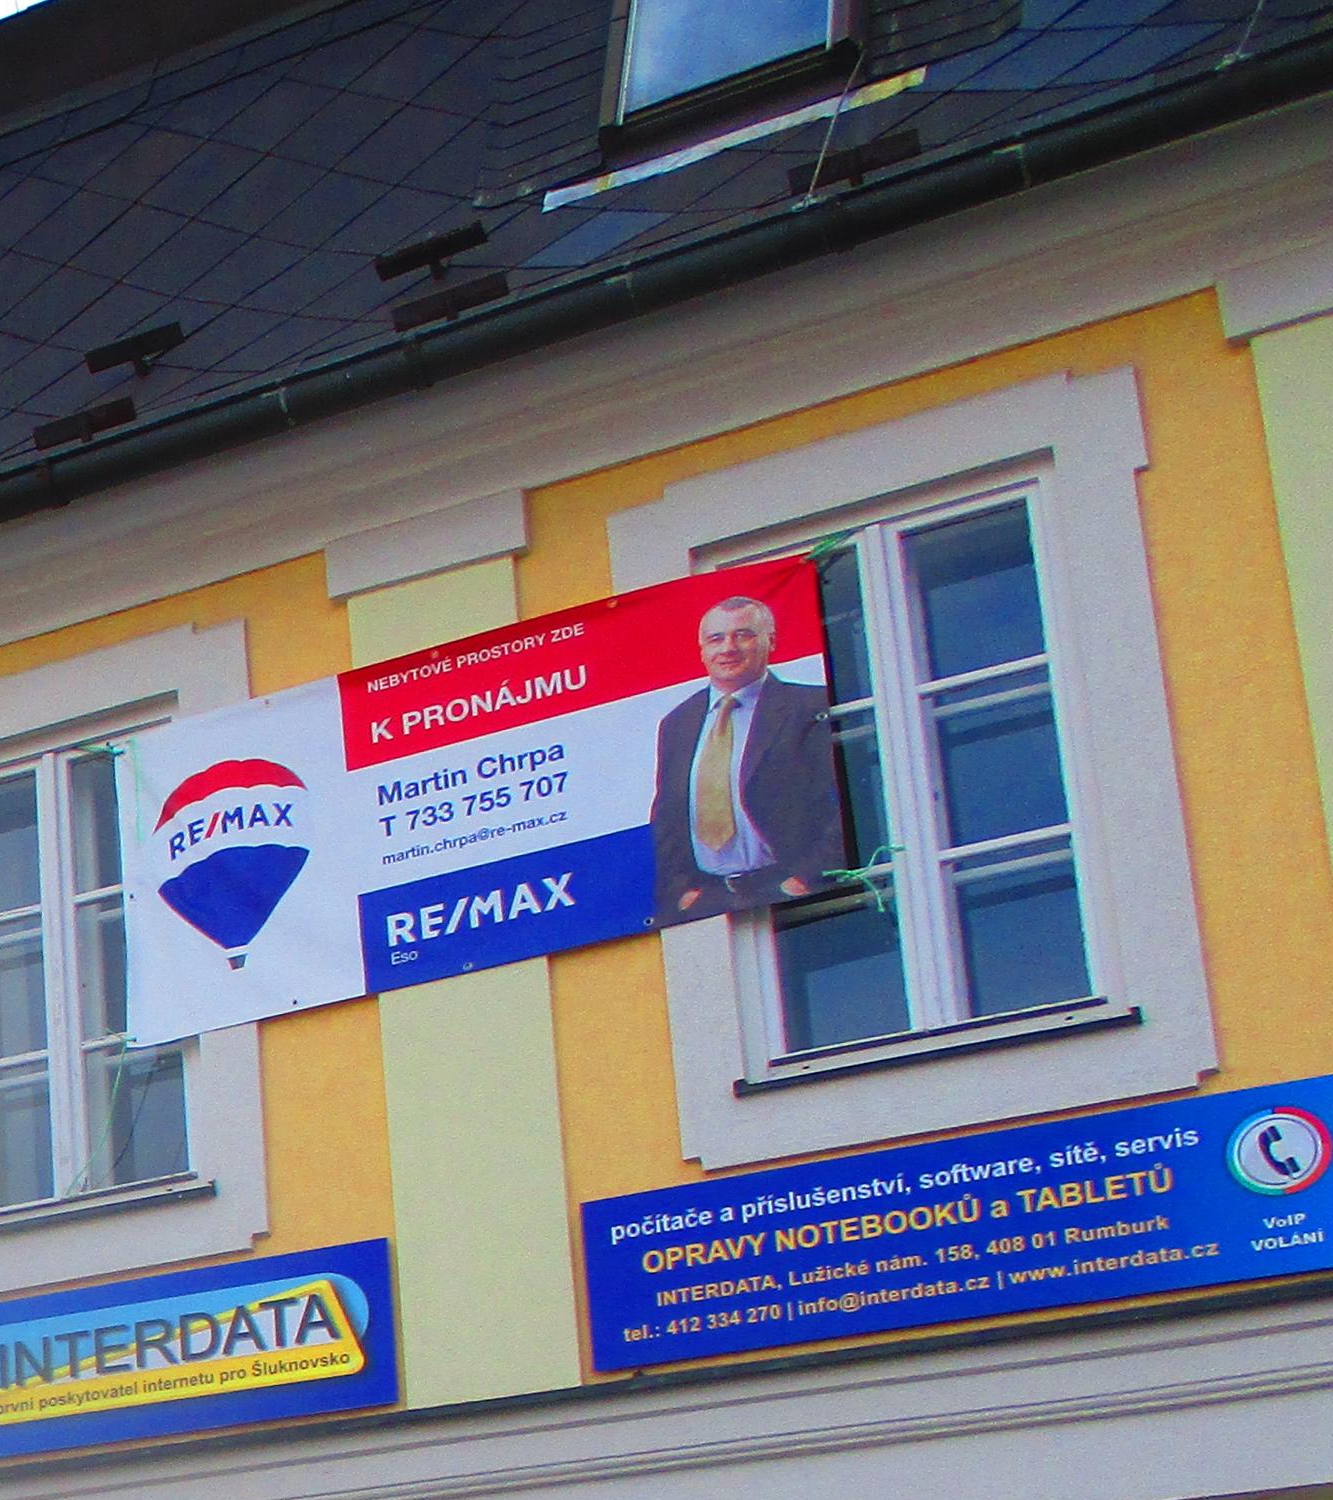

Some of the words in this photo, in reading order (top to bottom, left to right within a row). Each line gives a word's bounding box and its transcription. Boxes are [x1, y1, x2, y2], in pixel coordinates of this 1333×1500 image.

[367, 656, 452, 693] NEBYTOVÉ
[457, 633, 545, 669] PROSTORY
[550, 622, 585, 643] ZDE
[370, 717, 394, 744] K
[402, 664, 587, 735] PRONÁJMU
[377, 768, 467, 806] Martin
[476, 744, 565, 779] Chrpa
[379, 815, 397, 837] T
[405, 801, 455, 831] 733
[462, 786, 511, 816] 755
[519, 771, 569, 801] 707
[168, 803, 293, 861] RE/MAX
[382, 810, 568, 865] martin.chrpa@re-max.cz
[386, 871, 576, 947] RE/MAX
[390, 951, 419, 966] Eso
[610, 1207, 713, 1245] počítače
[719, 1206, 734, 1223] a
[741, 1173, 912, 1223] příslušenství,
[919, 1155, 1041, 1190] software,
[1049, 1141, 1107, 1168] sítě,
[1115, 1127, 1201, 1158] servis
[642, 1232, 766, 1274] OPRAVY
[774, 1193, 982, 1253] NOTEBOOKŮ
[990, 1199, 1010, 1219] a
[1016, 1163, 1174, 1214] TABLETŮ
[1250, 1227, 1325, 1251] VOLÁNÍ
[1262, 1212, 1307, 1229] VoIP
[623, 1326, 661, 1343] tel.:
[667, 1317, 701, 1336] 412
[707, 1309, 741, 1329] 334
[746, 1304, 781, 1324] 270
[799, 1274, 990, 1316] info@interdata.cz
[1008, 1243, 1219, 1285] www.interdata.cz
[656, 1274, 782, 1307] INTERDATA,
[788, 1255, 870, 1287] Lužické
[875, 1253, 927, 1274] nám.
[935, 1244, 980, 1264] 158,
[986, 1235, 1026, 1256] 408
[1031, 1231, 1056, 1250] 01
[1064, 1214, 1170, 1244] Rumburk
[38, 1384, 138, 1412] poskytovatel
[143, 1373, 214, 1393] internetu
[219, 1368, 247, 1385] pro
[252, 1352, 351, 1378] Šluknovsko
